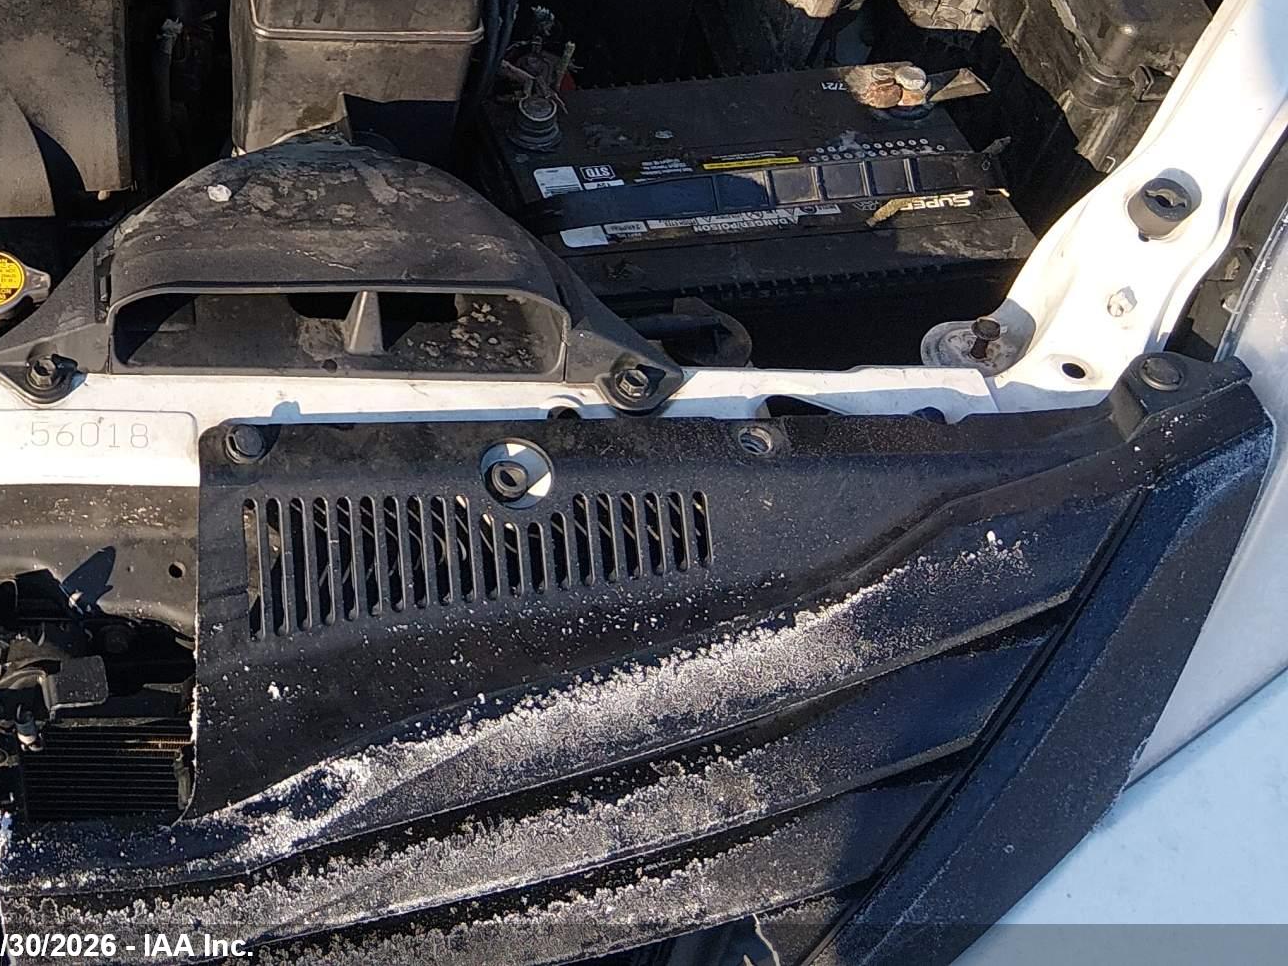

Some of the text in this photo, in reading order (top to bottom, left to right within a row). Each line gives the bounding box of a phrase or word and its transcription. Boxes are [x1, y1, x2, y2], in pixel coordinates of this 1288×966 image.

[585, 166, 610, 178] STD
[693, 216, 789, 233] DANGER/POISON
[30, 421, 150, 449] 56018
